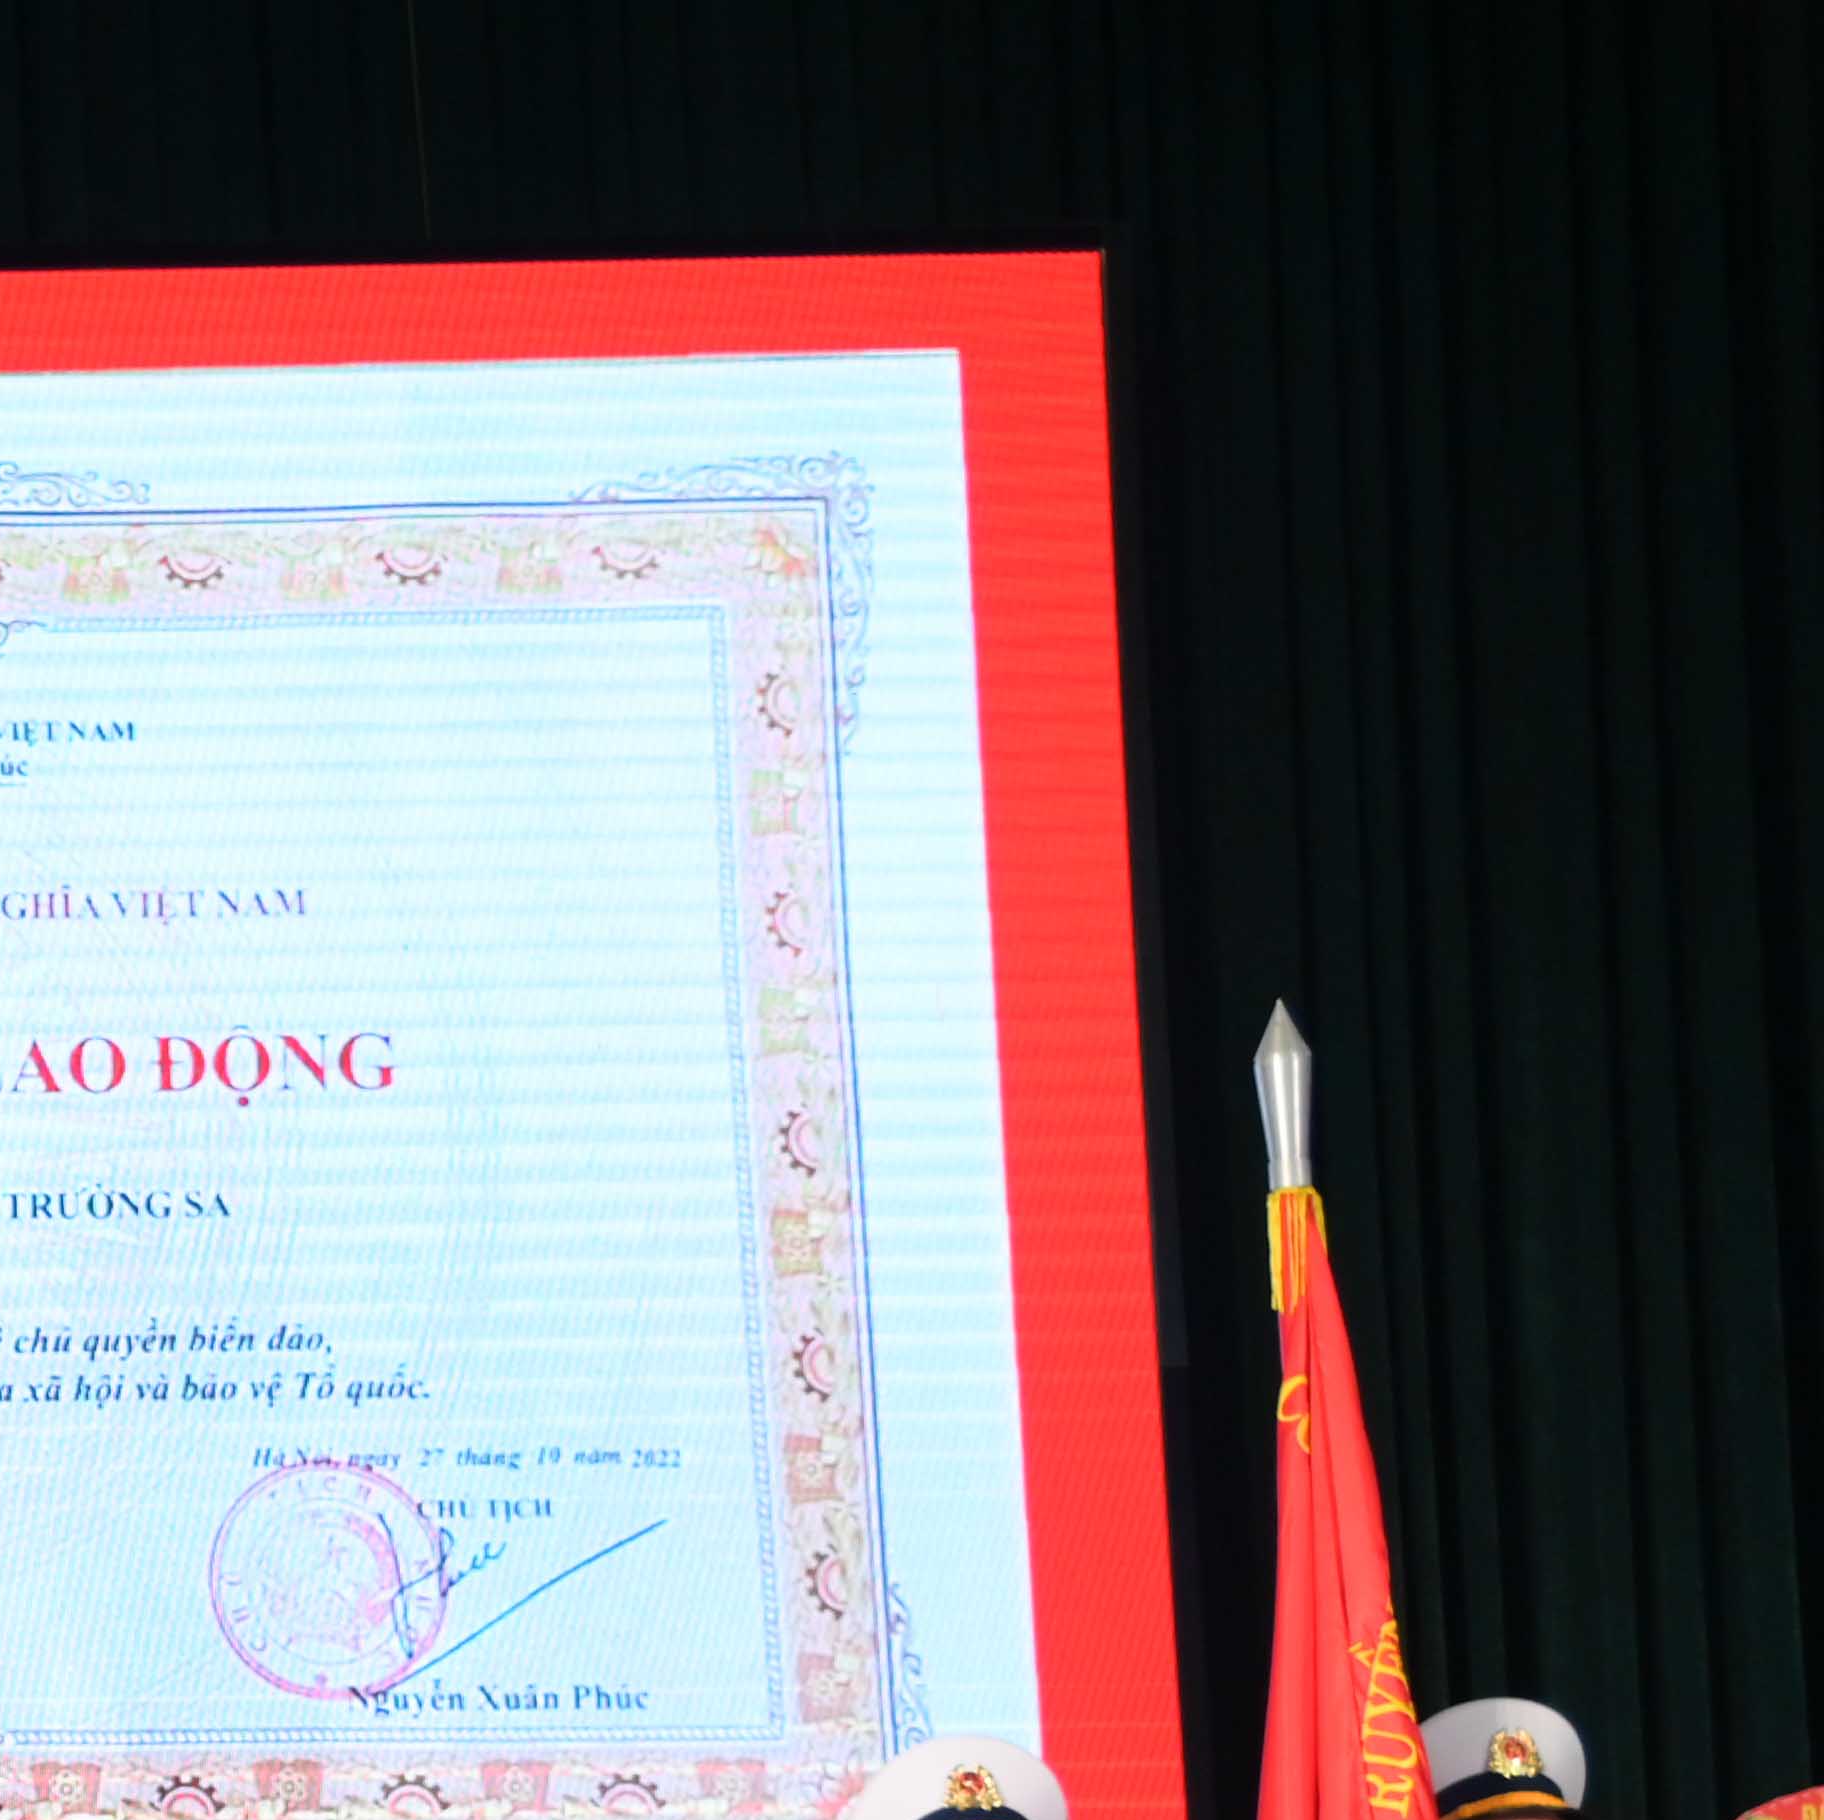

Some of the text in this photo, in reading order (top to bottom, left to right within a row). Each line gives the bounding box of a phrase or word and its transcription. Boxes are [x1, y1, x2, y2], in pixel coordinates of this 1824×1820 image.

[68, 720, 138, 743] NAM
[111, 888, 204, 927] VIỆT
[217, 889, 307, 919] NAM
[150, 1024, 395, 1107] ĐỘNG
[2, 1183, 172, 1221] TRƯỜNG
[184, 1190, 231, 1218] SA
[13, 1325, 72, 1354] chủ
[83, 1317, 177, 1362] quyền
[189, 1316, 255, 1353] biển
[267, 1323, 333, 1355] đảo,
[23, 1375, 62, 1402] xã
[74, 1373, 126, 1410] hội
[136, 1373, 169, 1401] và
[181, 1372, 238, 1402] bảo
[251, 1371, 283, 1408] vệ
[296, 1363, 336, 1400] Tổ
[346, 1362, 431, 1408] quốc.
[631, 1448, 682, 1469] 2022
[488, 1498, 553, 1523] TỊCH
[349, 1678, 650, 1718] Nguyễn Xuân Phúc
